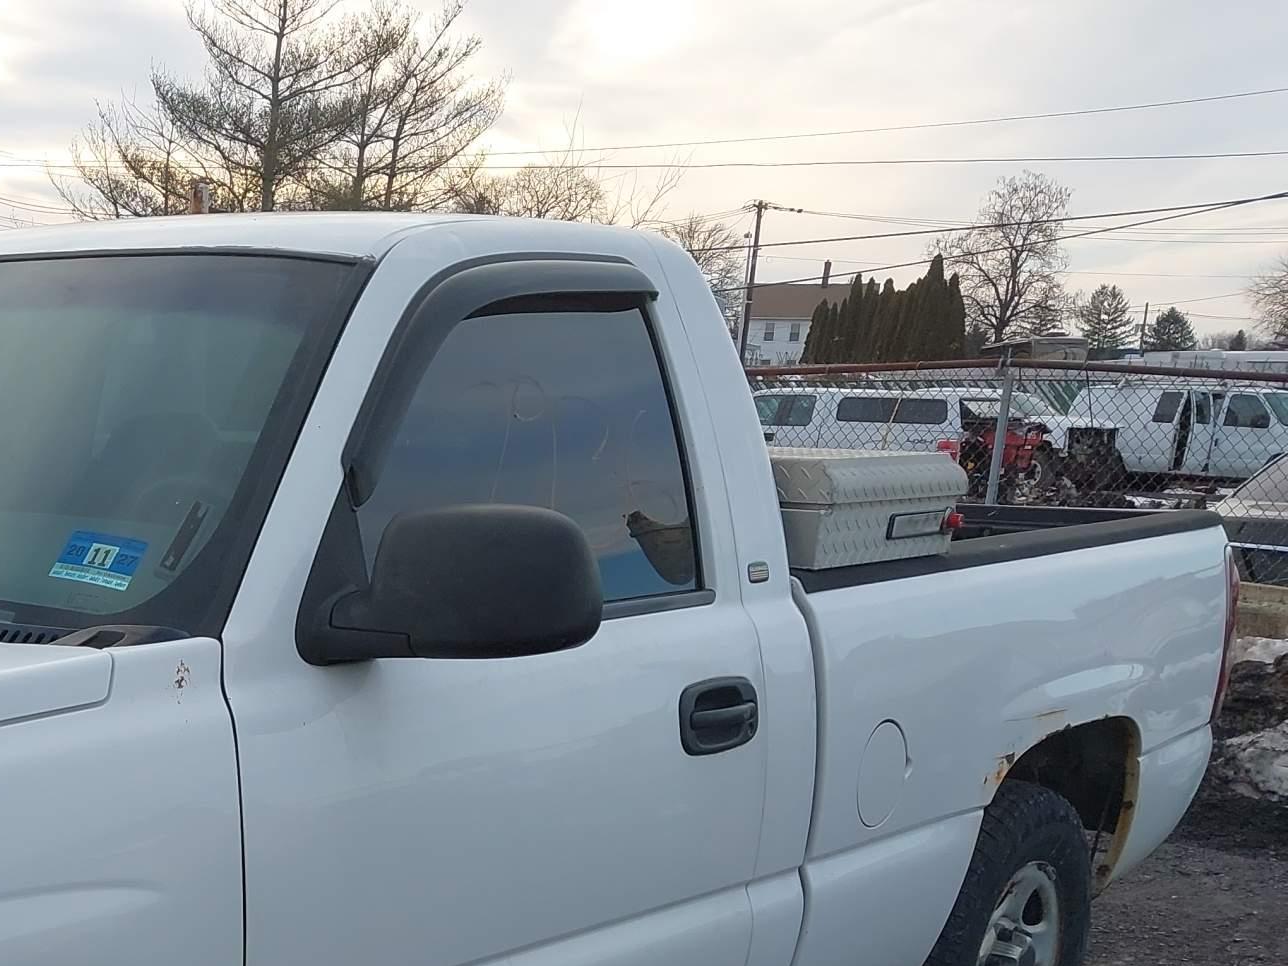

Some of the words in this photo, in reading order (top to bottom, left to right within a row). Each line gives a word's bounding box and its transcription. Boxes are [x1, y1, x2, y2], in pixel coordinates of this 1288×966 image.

[68, 544, 85, 556] 20
[87, 547, 111, 565] 11
[119, 554, 138, 566] 27
